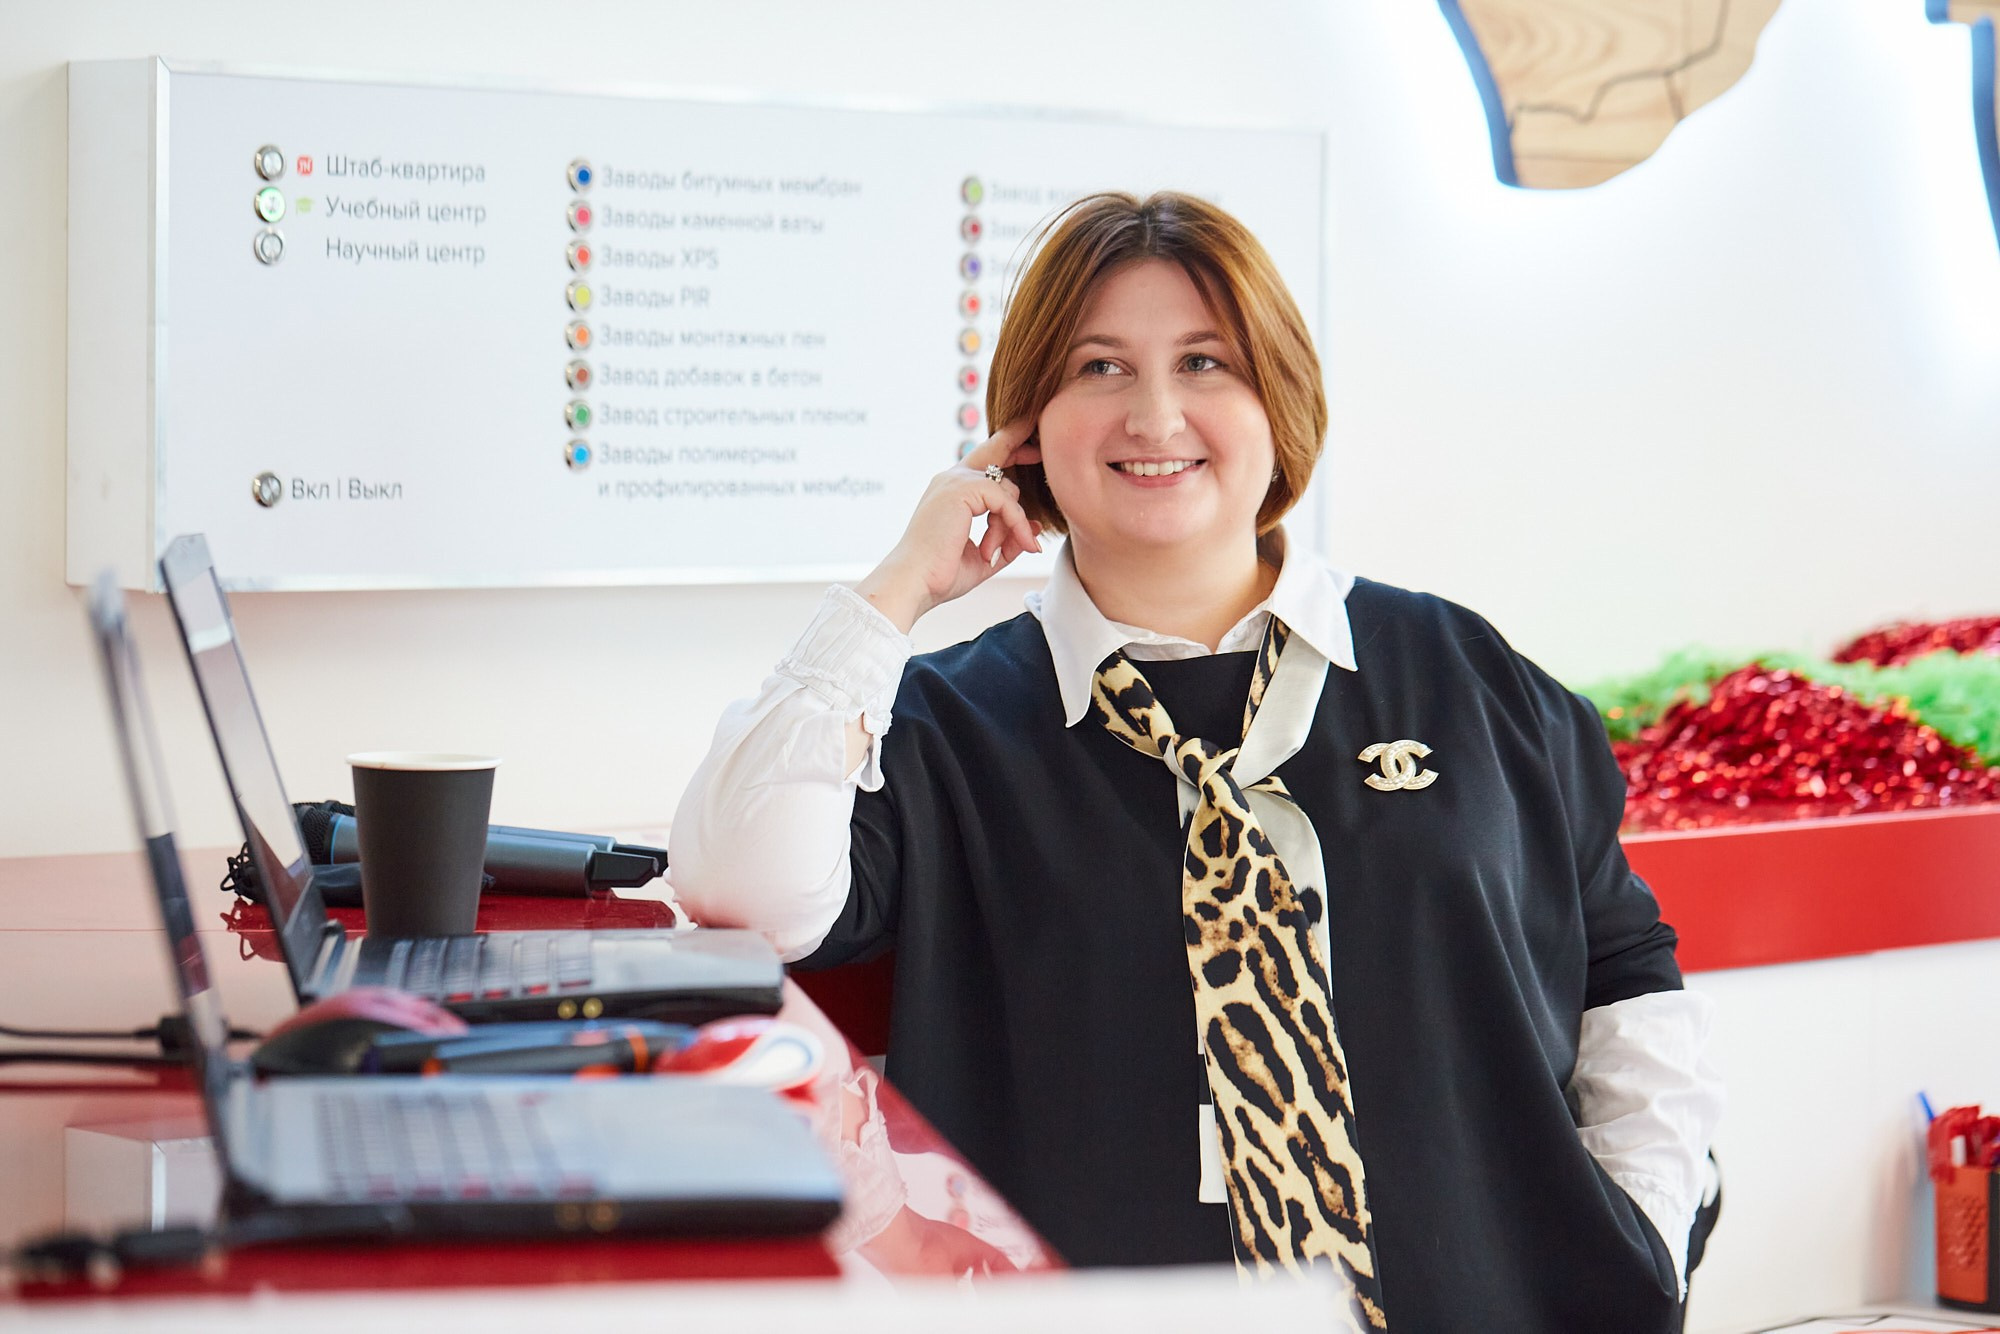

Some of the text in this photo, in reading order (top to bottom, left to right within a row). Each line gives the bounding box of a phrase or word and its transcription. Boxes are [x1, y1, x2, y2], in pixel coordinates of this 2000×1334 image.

[326, 155, 486, 184] Штаб-квартира
[601, 164, 863, 200] Заводы битумных мембран
[325, 196, 487, 227] Учебный центр
[601, 204, 825, 234] Заводы каменной ваты
[326, 237, 486, 267] Научный центр
[600, 244, 720, 270] Заводы XPS
[600, 284, 711, 309] Заводы PIR
[600, 324, 826, 348] Заводы монтажных пен
[599, 362, 823, 387] Завод добавок в бетон
[599, 402, 868, 428] Завод строительных пленок
[599, 442, 798, 467] Заводы полимерных
[291, 478, 330, 499] Вкл
[348, 478, 403, 499] Выкл
[598, 477, 885, 501] и профилированных мембран
